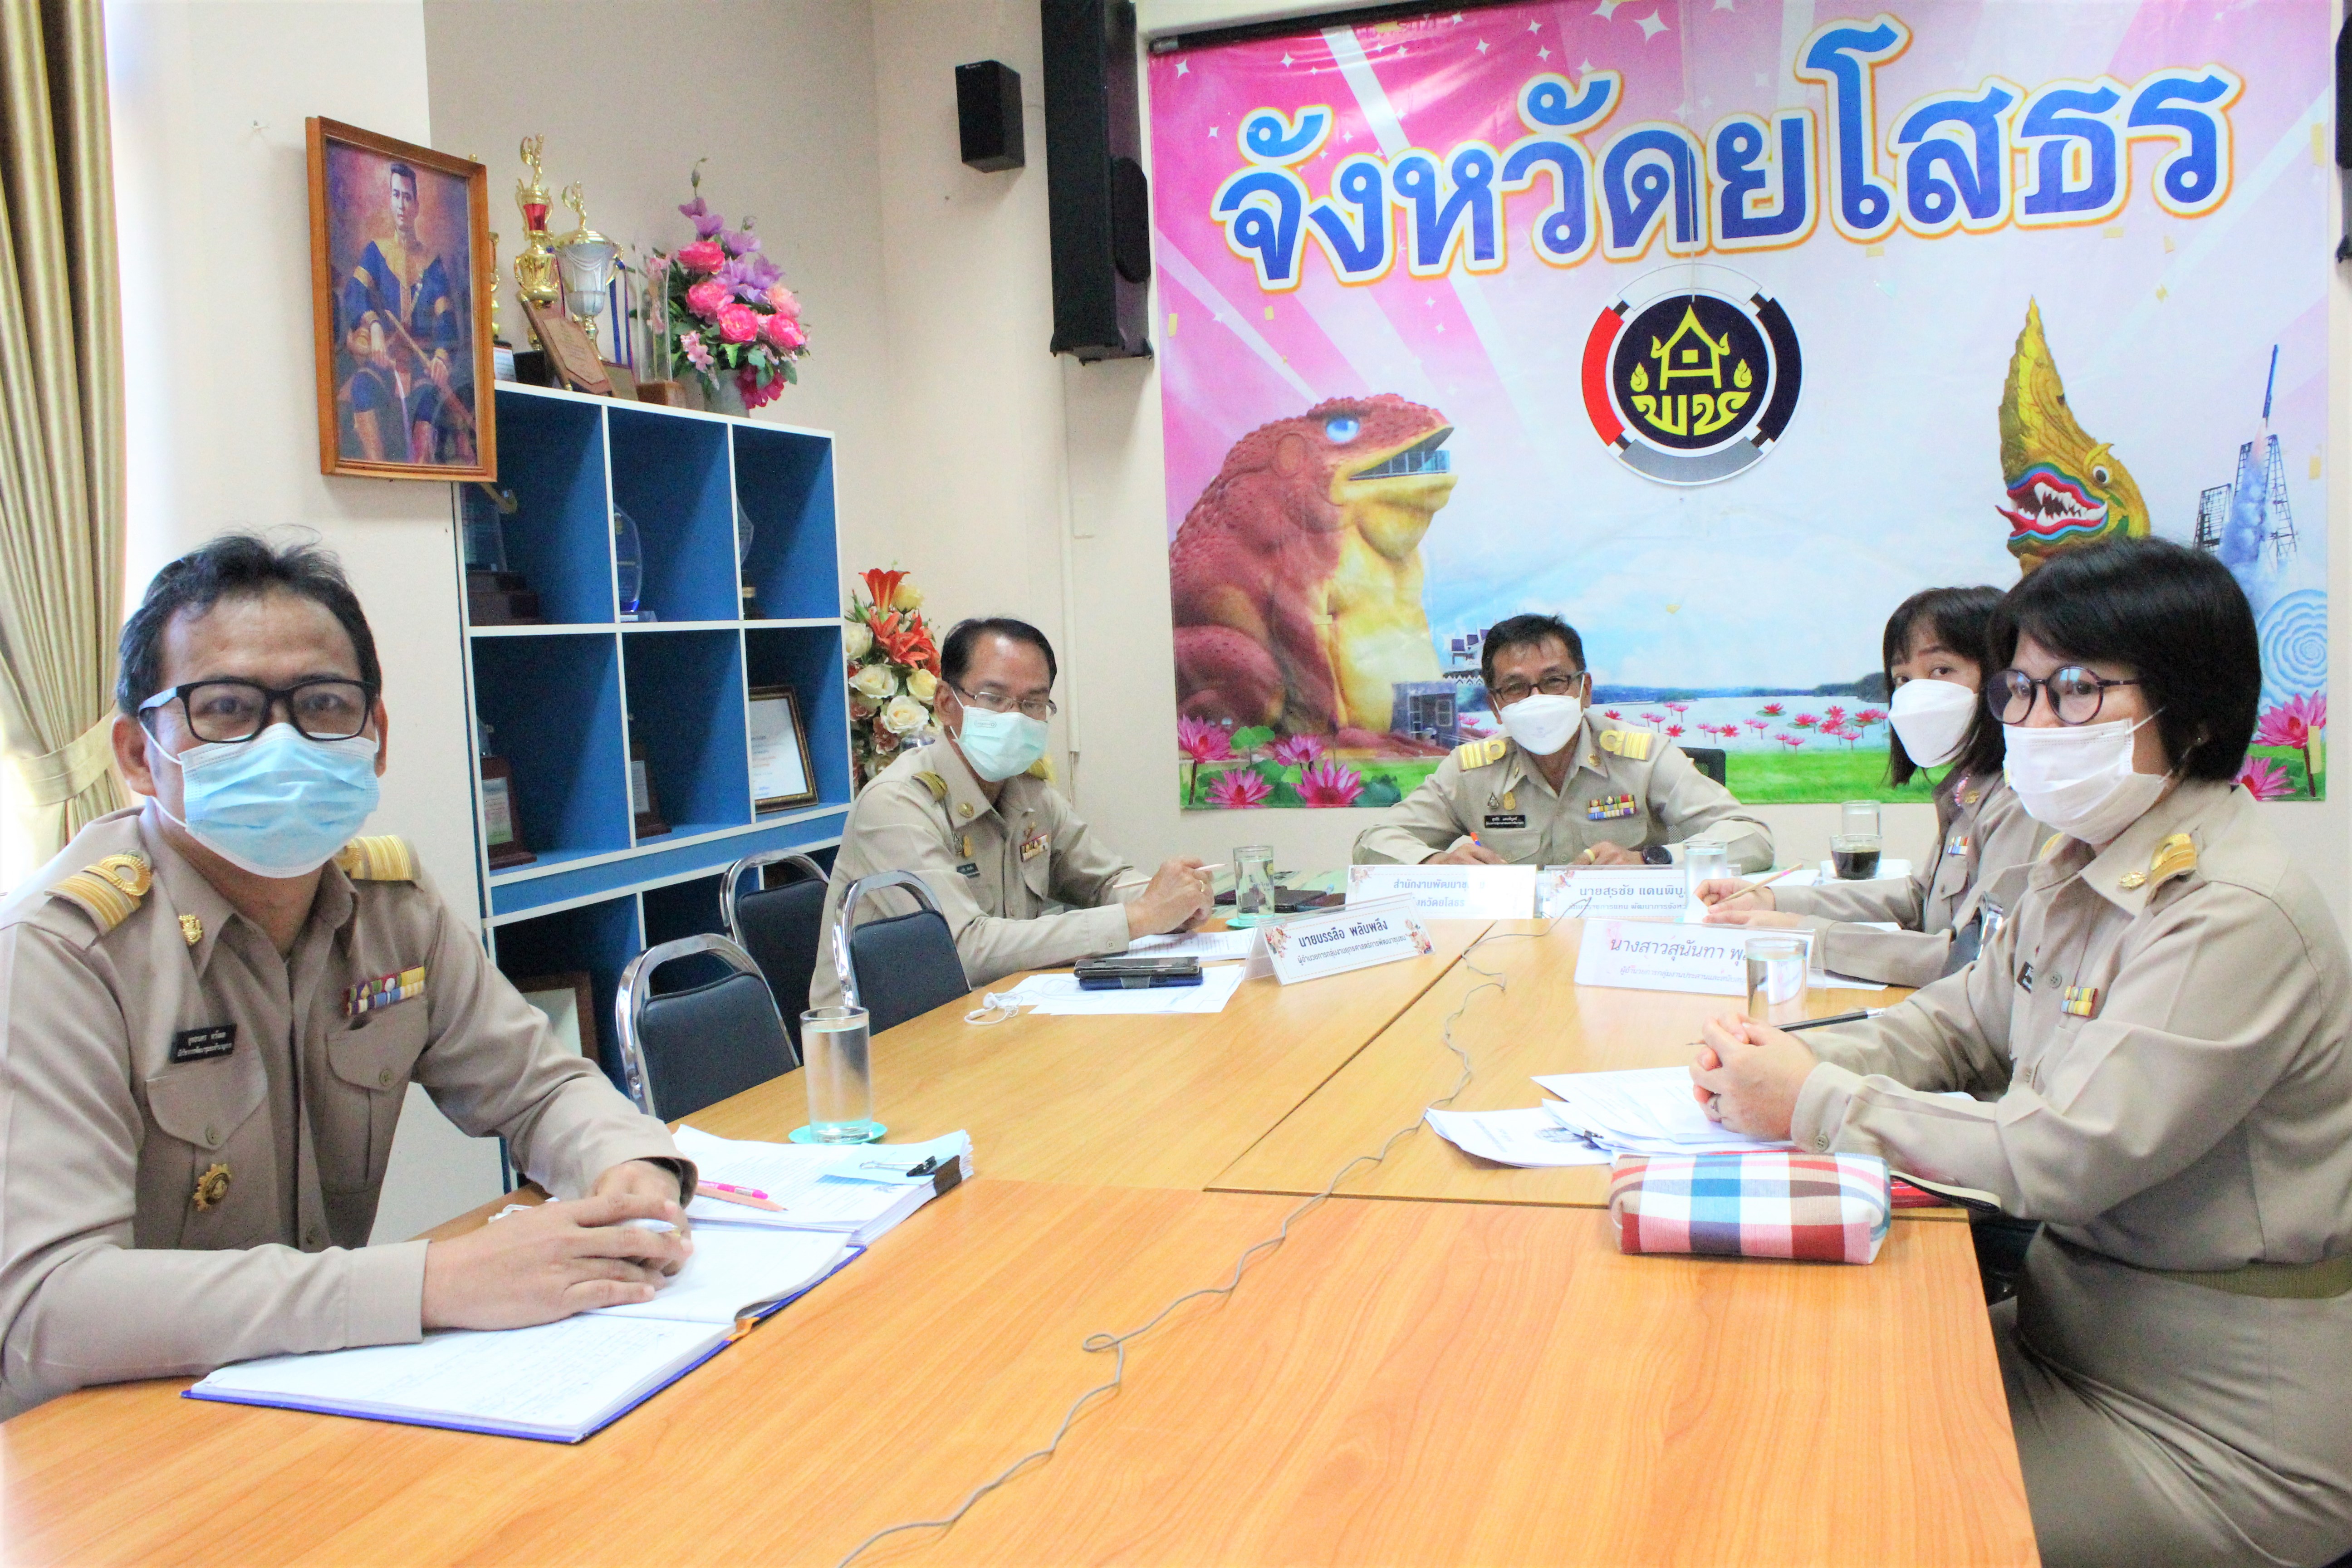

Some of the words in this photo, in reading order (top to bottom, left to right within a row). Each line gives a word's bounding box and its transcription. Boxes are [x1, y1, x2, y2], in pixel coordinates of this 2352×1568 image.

[1220, 23, 2229, 280] จังหวัดยโสธร
[1580, 884, 1634, 898] นายสุรชัย
[1639, 885, 1686, 898] แดนพิบู
[1298, 926, 1345, 947] นายบรรลือ
[1349, 918, 1388, 937] พลับพลึง
[1610, 939, 1725, 961] นางสาวสุนันทา
[1620, 966, 1746, 984] ผู้อำนวยการกลุ่มงานประสานและสนับสนุ
